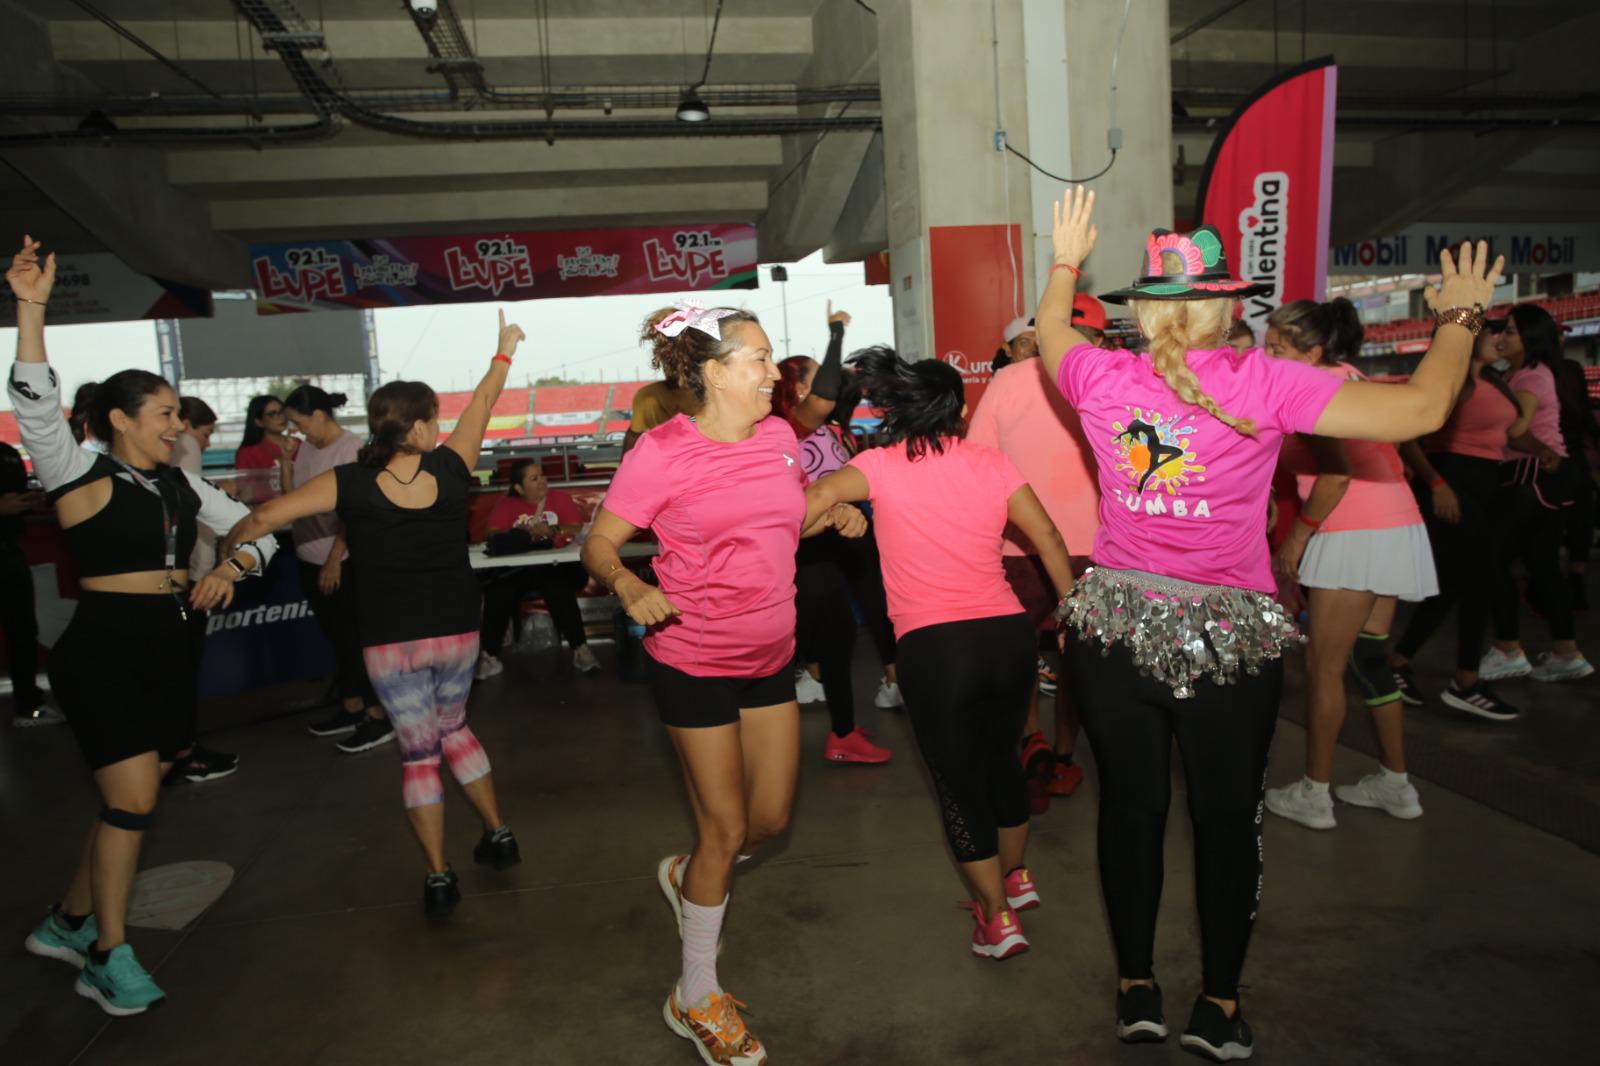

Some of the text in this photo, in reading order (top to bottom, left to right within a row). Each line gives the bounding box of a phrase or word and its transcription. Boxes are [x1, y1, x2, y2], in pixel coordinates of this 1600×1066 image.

[478, 242, 512, 256] 92.1
[676, 234, 708, 248] 92.1
[1334, 235, 1574, 267] Mobil Mol Mobil
[205, 600, 315, 636] porteni
